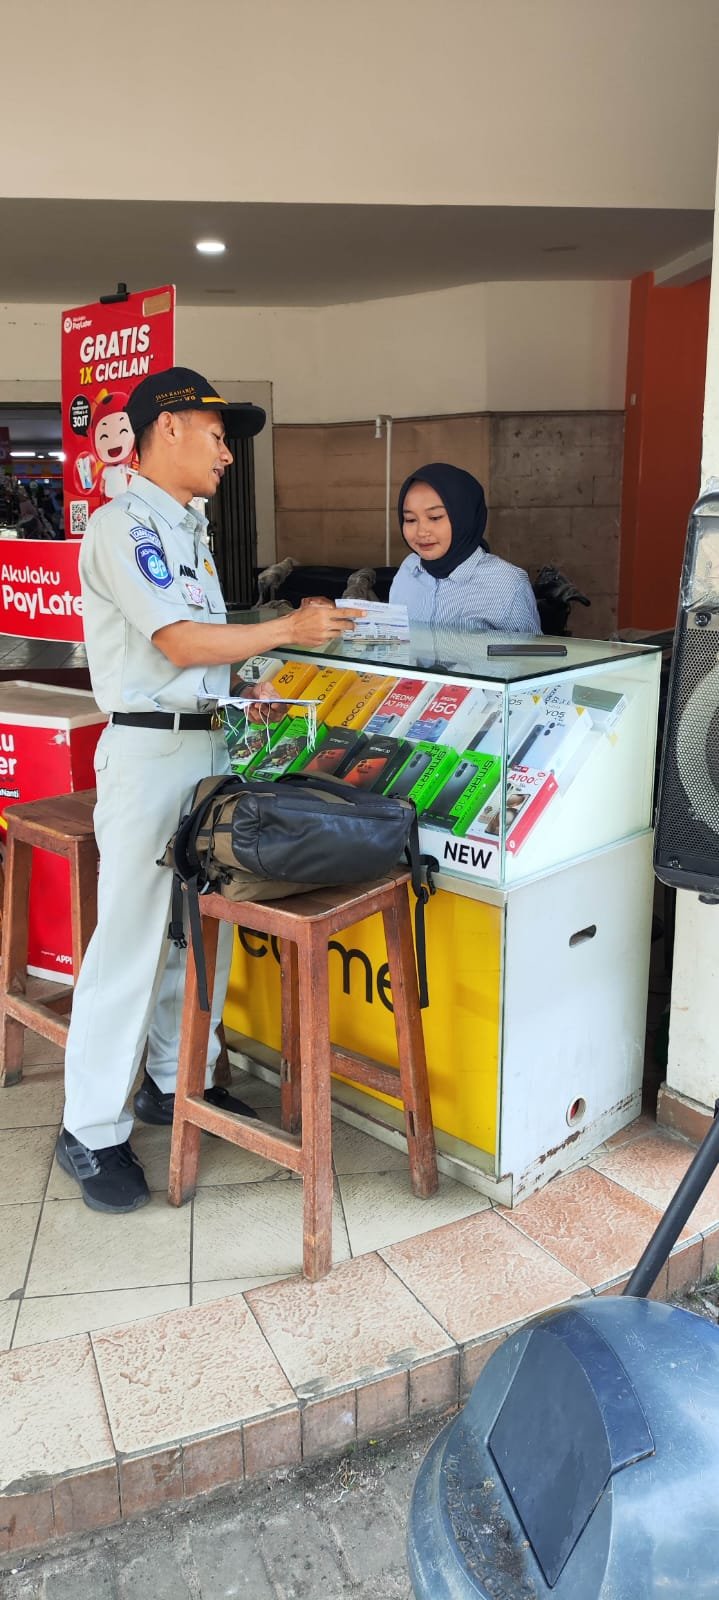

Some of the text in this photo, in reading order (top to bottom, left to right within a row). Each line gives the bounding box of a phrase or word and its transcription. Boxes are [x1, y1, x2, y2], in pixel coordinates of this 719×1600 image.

[80, 324, 150, 363] GRATIS
[80, 366, 93, 385] 1X
[72, 415, 88, 428] 30JT
[1, 564, 61, 586] Akulaku
[2, 585, 84, 620] PayLate
[390, 693, 415, 702] REDMI
[429, 701, 457, 714] 15C
[341, 701, 365, 727] POCO
[419, 751, 447, 789] SMART
[466, 760, 494, 799] SMART
[443, 841, 492, 869] NEW
